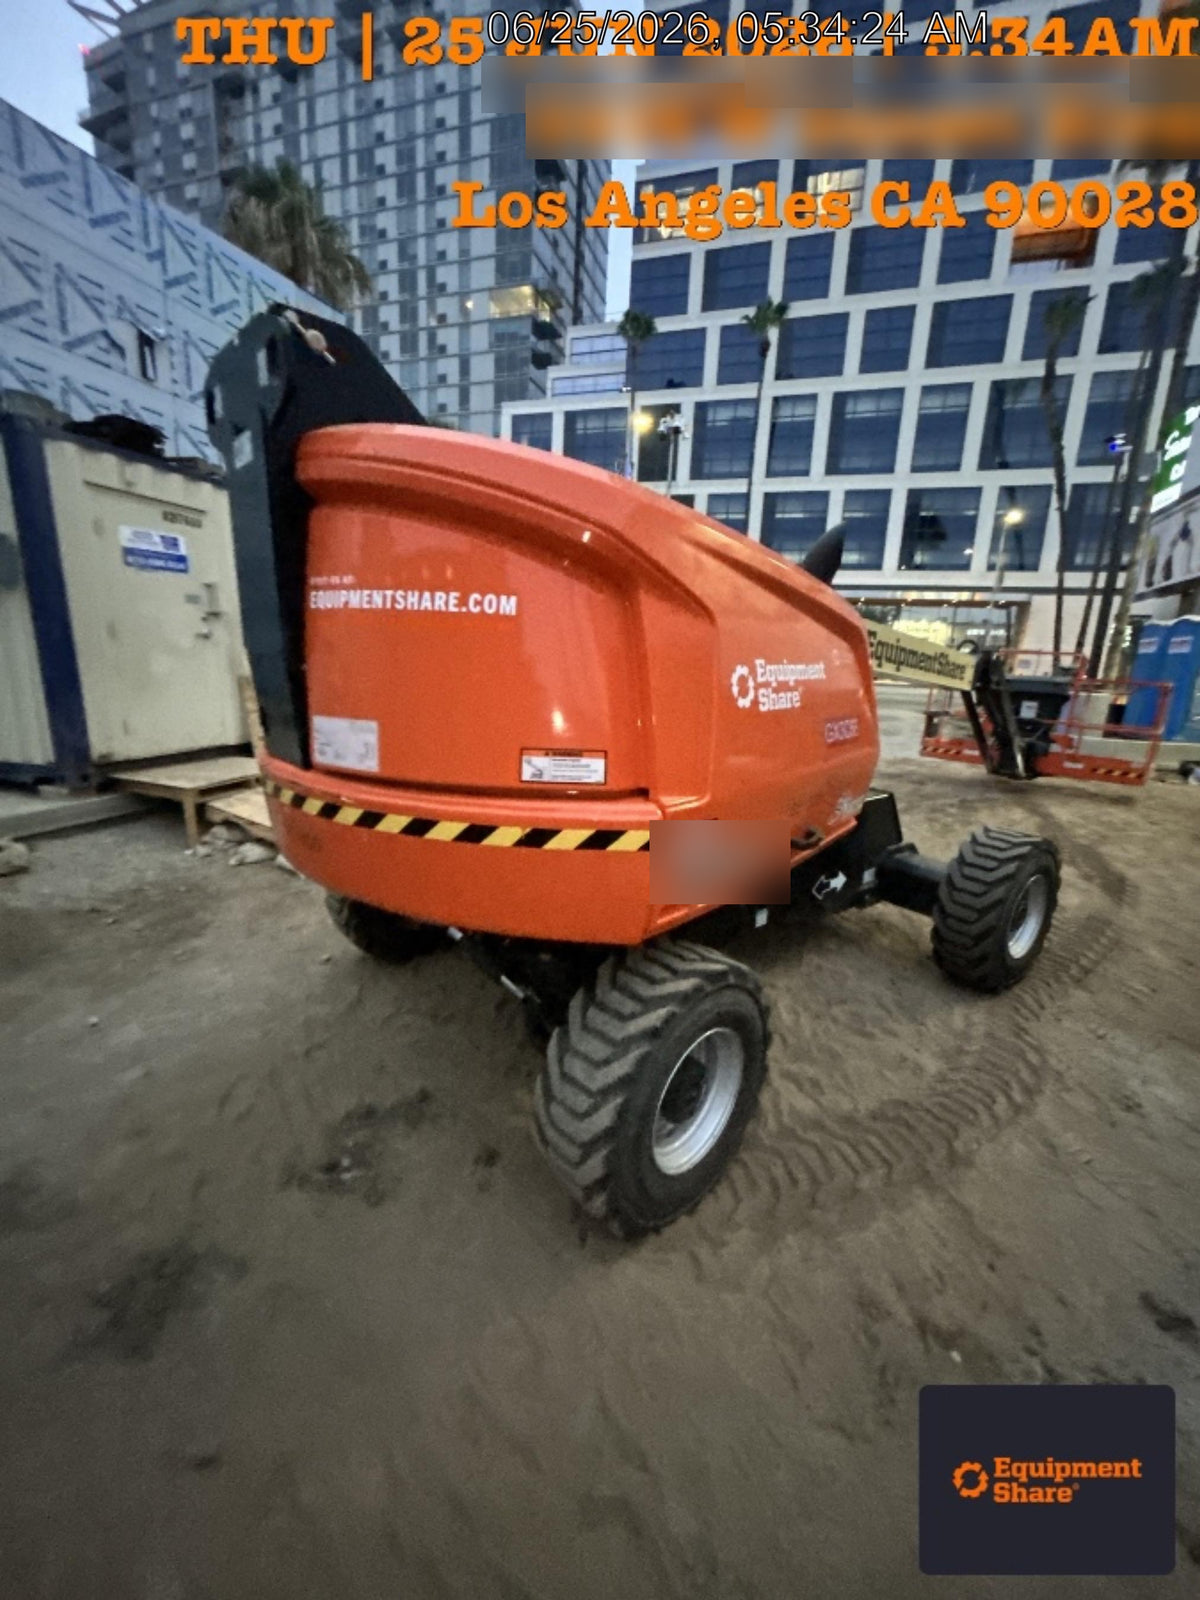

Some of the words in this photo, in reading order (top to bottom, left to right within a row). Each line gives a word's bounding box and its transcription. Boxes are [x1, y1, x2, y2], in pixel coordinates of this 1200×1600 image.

[310, 590, 518, 616] EQUIPMENTSHARE.COM
[755, 658, 826, 687] Equipment
[758, 687, 801, 711] Share
